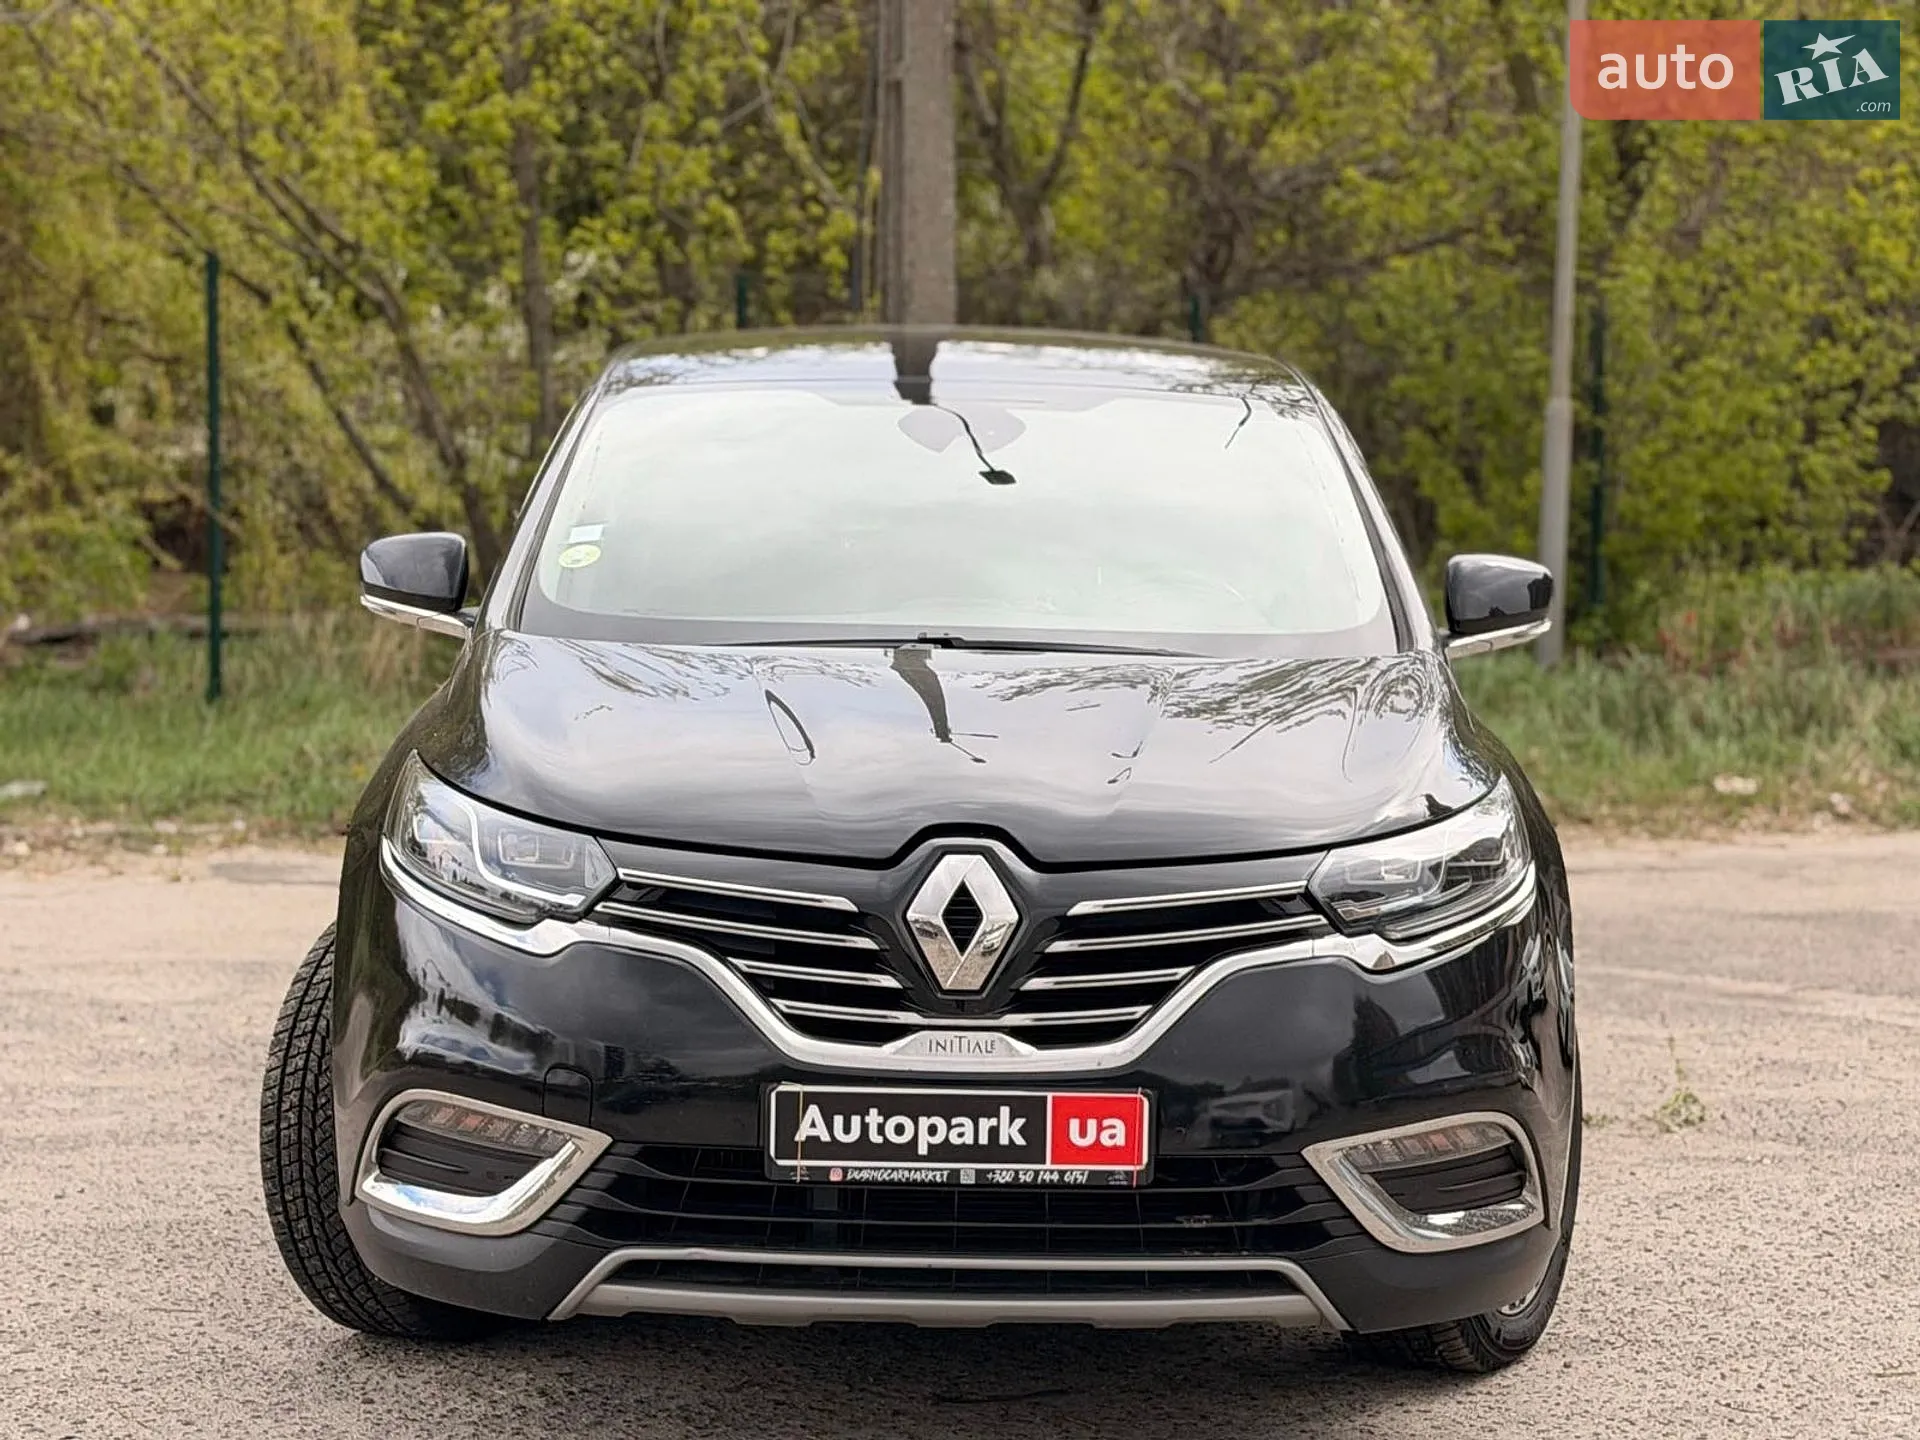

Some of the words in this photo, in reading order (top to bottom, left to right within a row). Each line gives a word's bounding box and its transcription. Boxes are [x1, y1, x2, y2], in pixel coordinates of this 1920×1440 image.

[928, 1035, 996, 1054] INITIALE
[794, 1103, 1028, 1156] Autopark
[1068, 1115, 1126, 1147] ua
